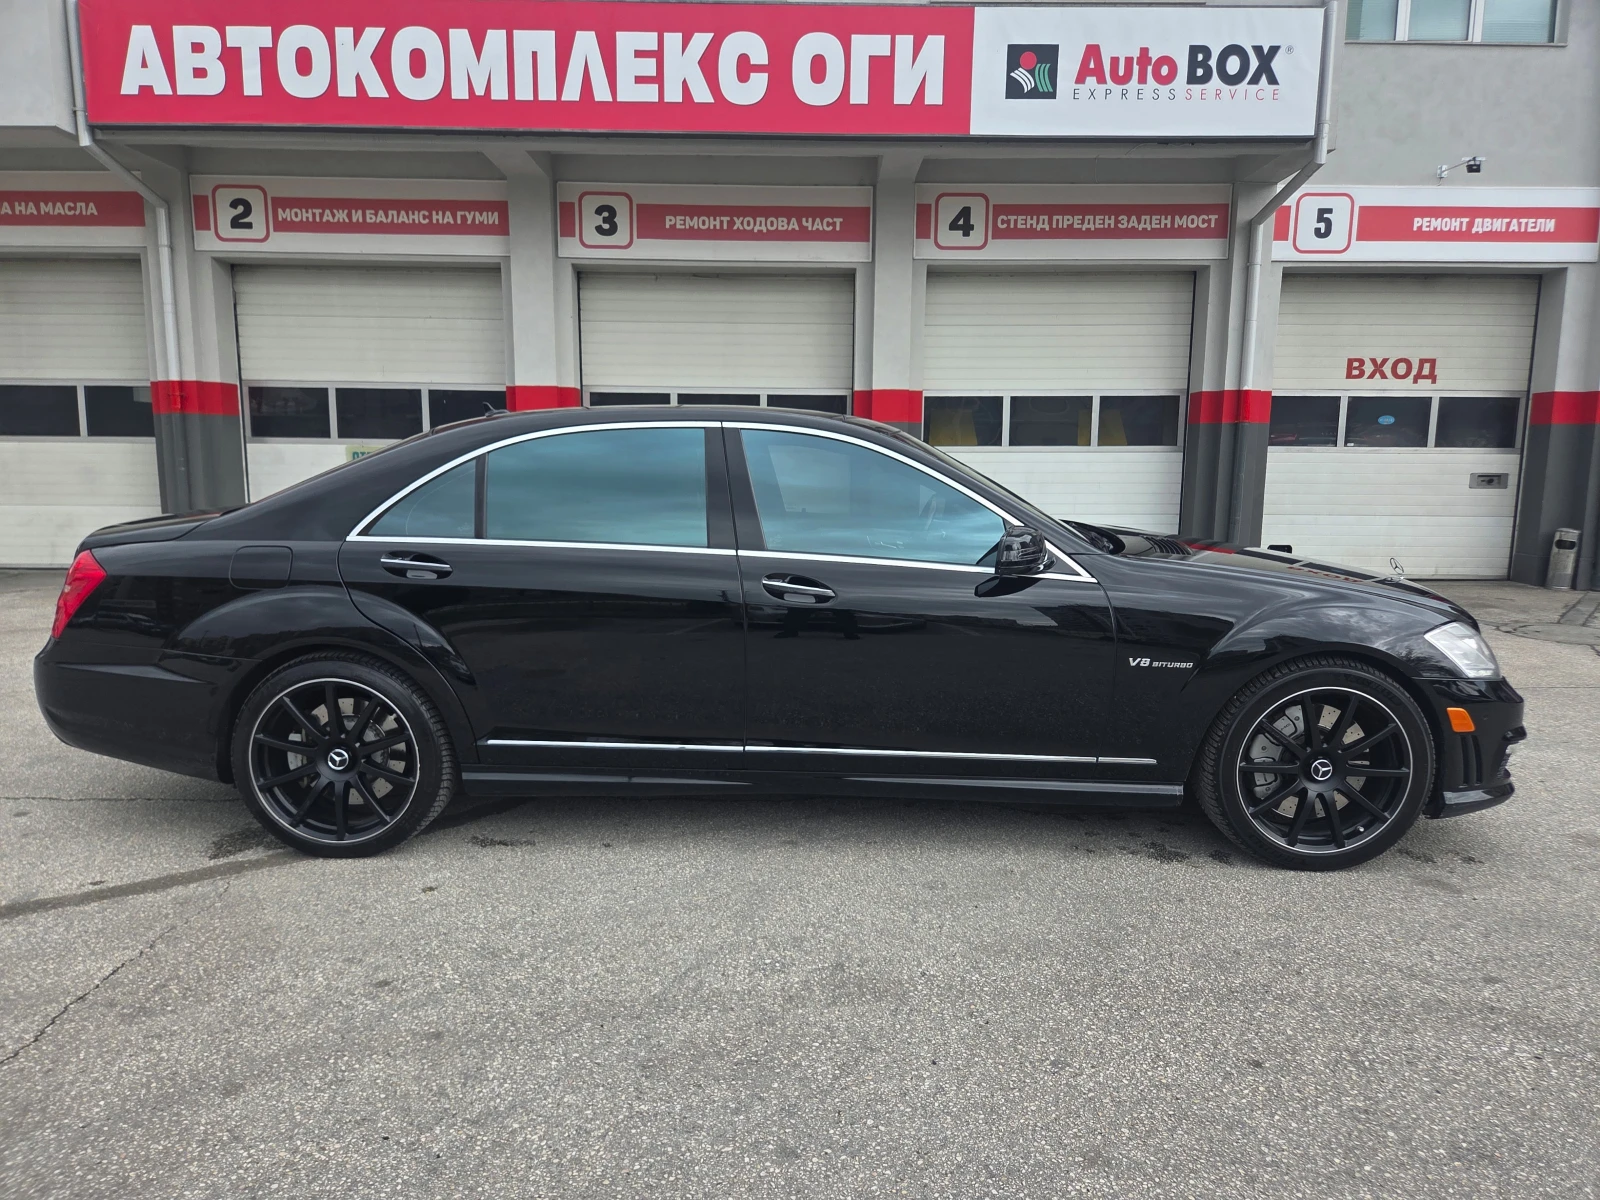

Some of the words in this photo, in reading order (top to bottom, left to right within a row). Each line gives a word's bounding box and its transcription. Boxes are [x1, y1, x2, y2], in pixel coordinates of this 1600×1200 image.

[120, 24, 769, 106] АВТОКОМПЛЕКС
[791, 31, 945, 106] ОГИ
[1074, 43, 1179, 86] Auto
[1186, 43, 1282, 87] BOX
[1072, 88, 1177, 101] EXPRESS
[1184, 88, 1281, 101] SERVICE
[14, 201, 38, 216] НА
[40, 201, 98, 216] МАСЛА
[228, 197, 254, 230] 2
[277, 208, 350, 223] МОНТАЖ
[351, 209, 363, 223] И
[365, 209, 430, 224] БАЛАНС
[432, 210, 455, 225] НА
[456, 210, 500, 225] ГУМИ
[594, 204, 619, 237] 3
[664, 215, 731, 230] РЕМОНТ
[732, 216, 800, 233] ХОДОВА
[801, 217, 844, 232] ЧАСТ
[948, 206, 975, 238] 4
[997, 215, 1050, 231] СТЕНД
[1052, 215, 1116, 231] ПРЕДЕН
[1117, 215, 1172, 231] ЗАДЕН
[1174, 214, 1219, 229] МОСТ
[1313, 207, 1334, 239] 5
[1412, 217, 1470, 232] РЕМОНТ
[1471, 217, 1557, 234] ДВИГАТЕЛИ
[1345, 357, 1438, 385] ВХОД
[1128, 657, 1151, 667] V8
[1151, 661, 1194, 669] BITURBO
